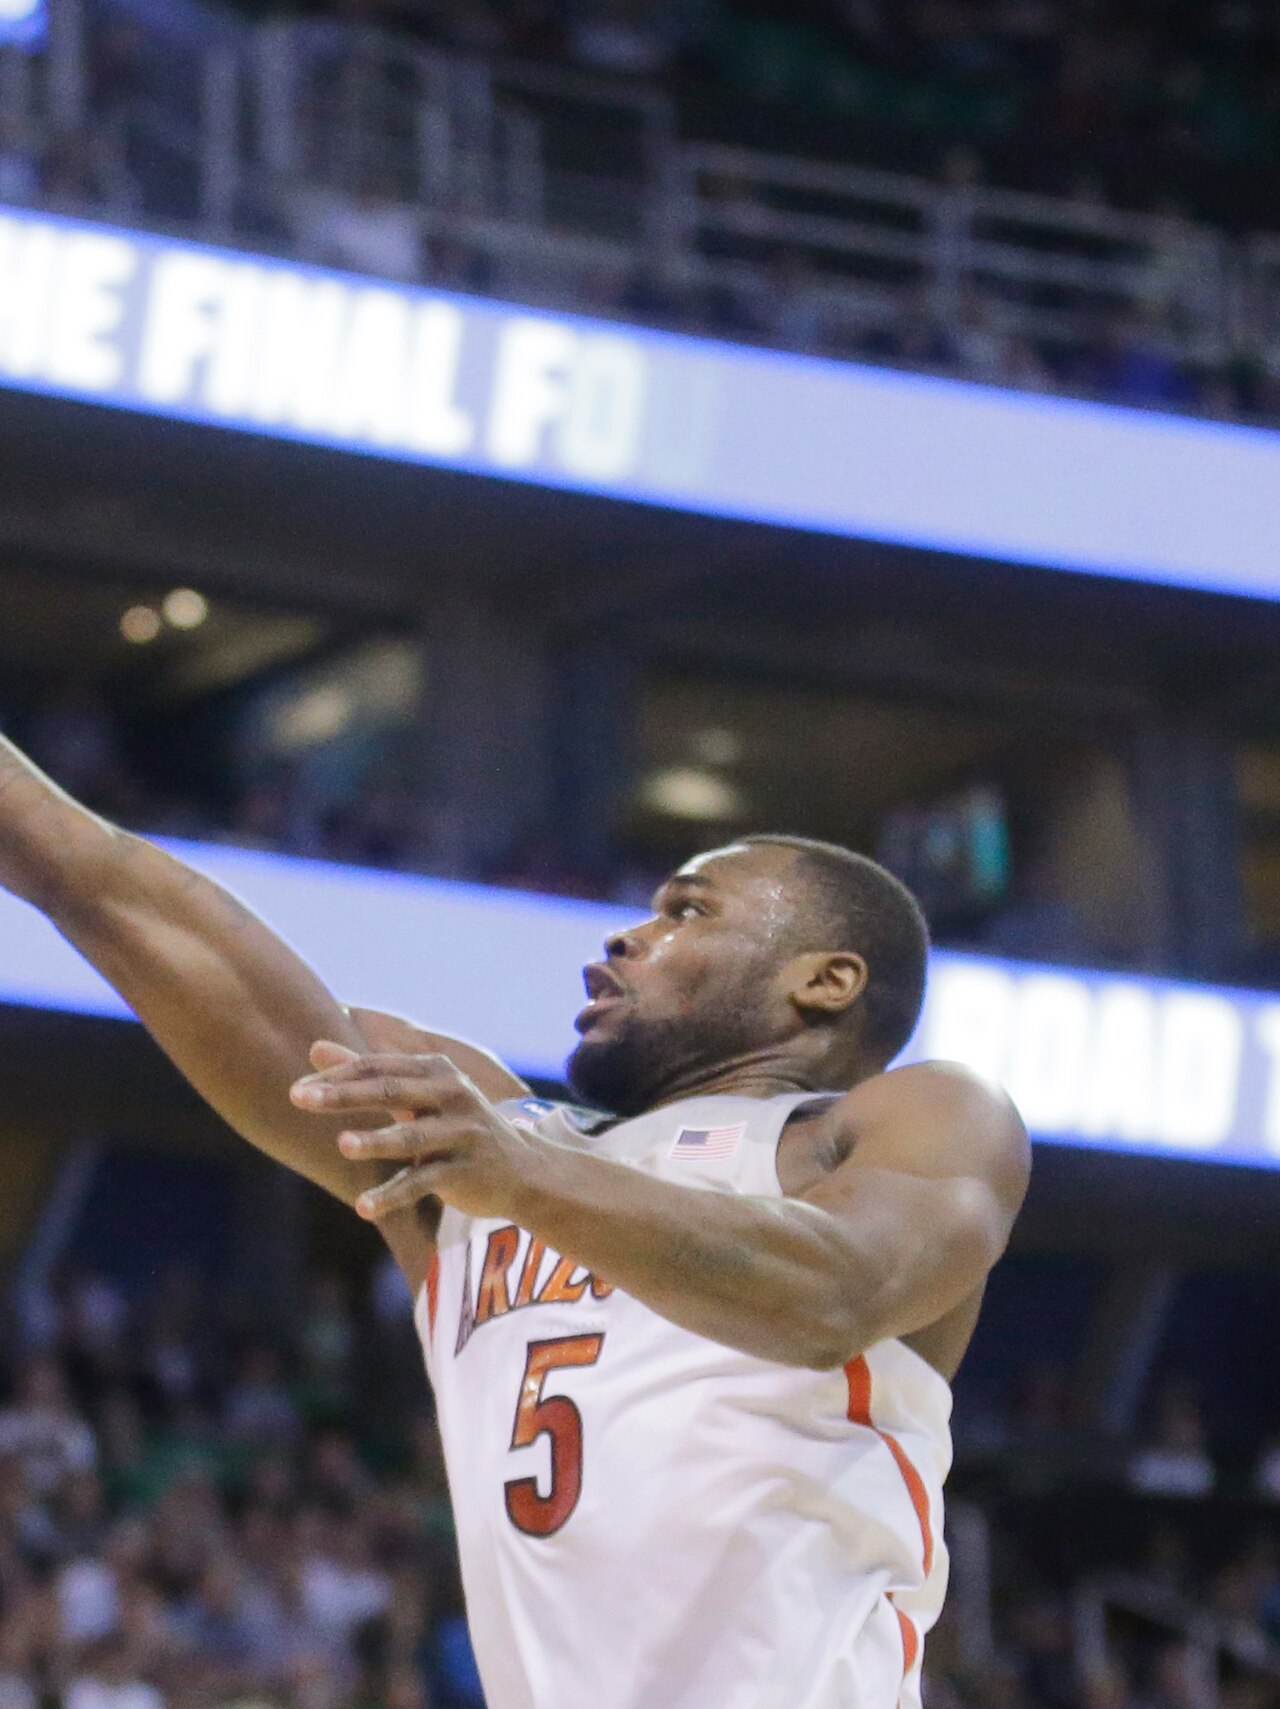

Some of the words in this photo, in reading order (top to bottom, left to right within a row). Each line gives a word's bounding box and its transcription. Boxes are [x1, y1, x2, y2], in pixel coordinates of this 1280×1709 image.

[139, 252, 472, 457] FINAL
[930, 966, 1241, 1146] ROAD
[504, 1332, 606, 1539] 5
